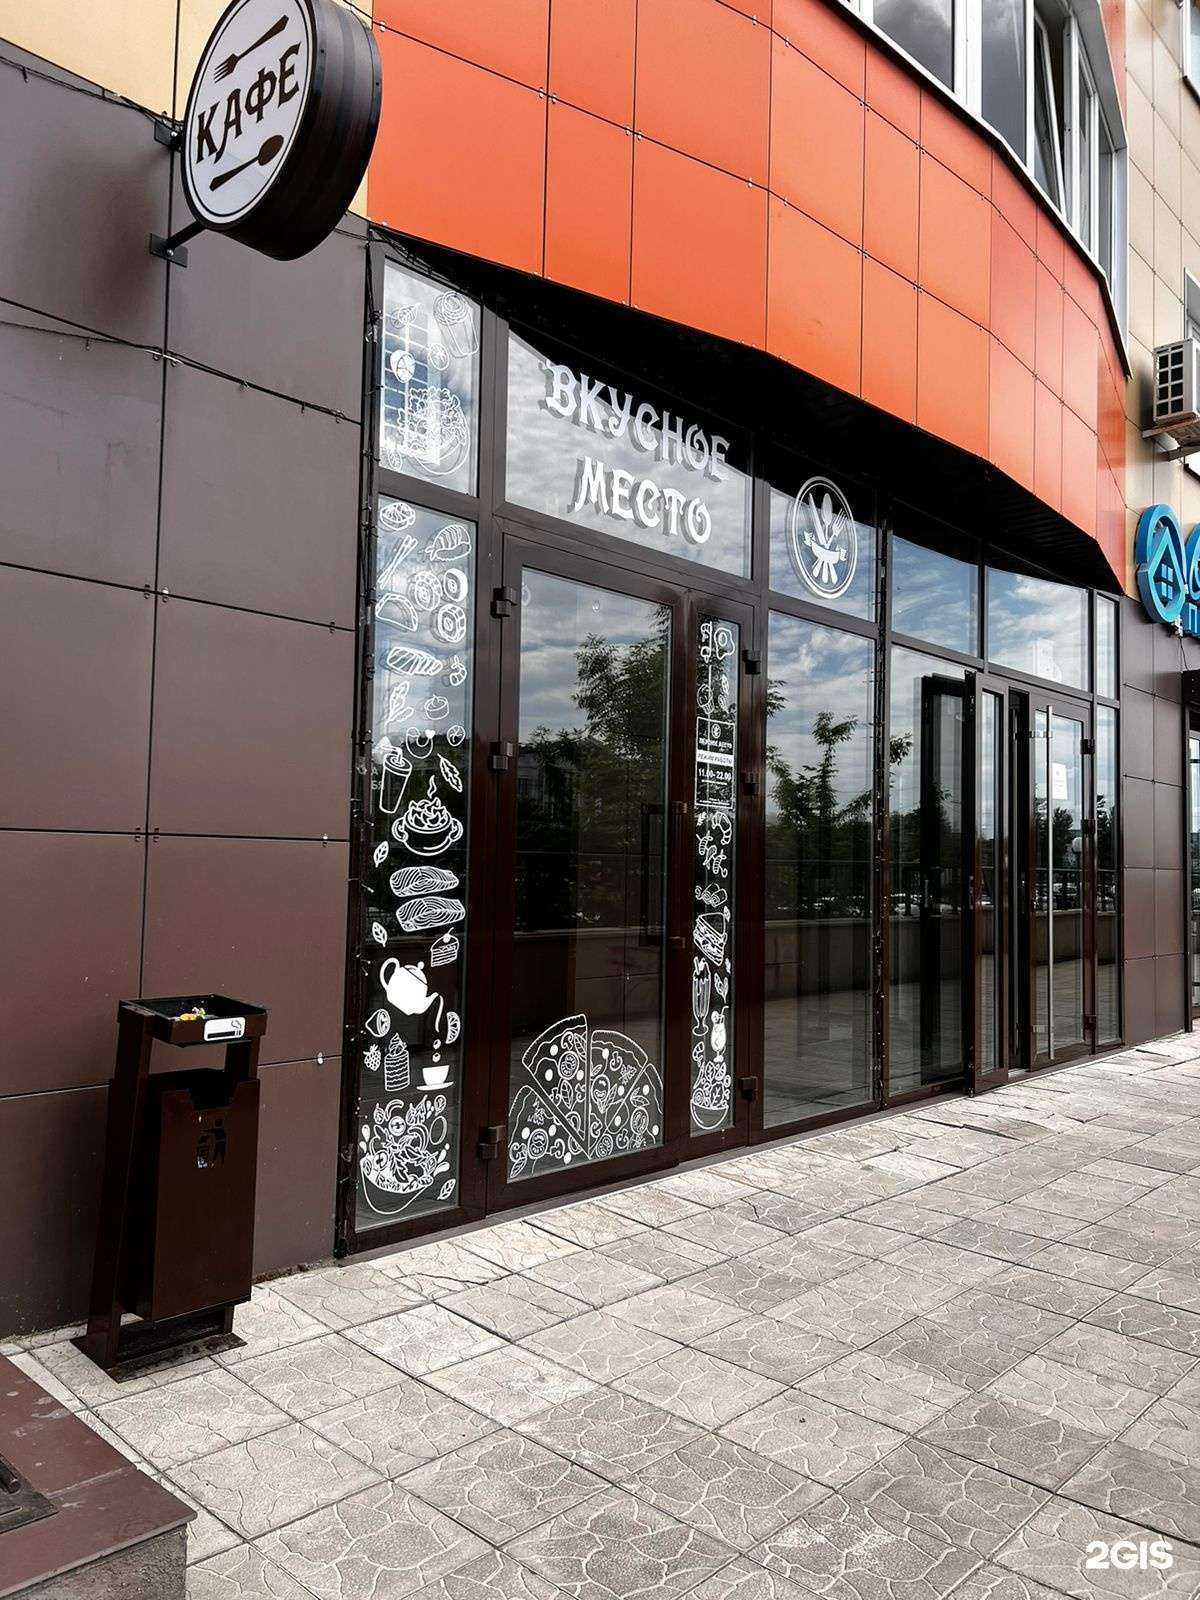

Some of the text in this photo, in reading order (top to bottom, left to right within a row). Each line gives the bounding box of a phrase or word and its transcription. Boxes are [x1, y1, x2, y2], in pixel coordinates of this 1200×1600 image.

[196, 41, 302, 164] КАФЕ
[545, 358, 730, 481] ВКУСНОЕ
[573, 455, 712, 544] МЕСТО
